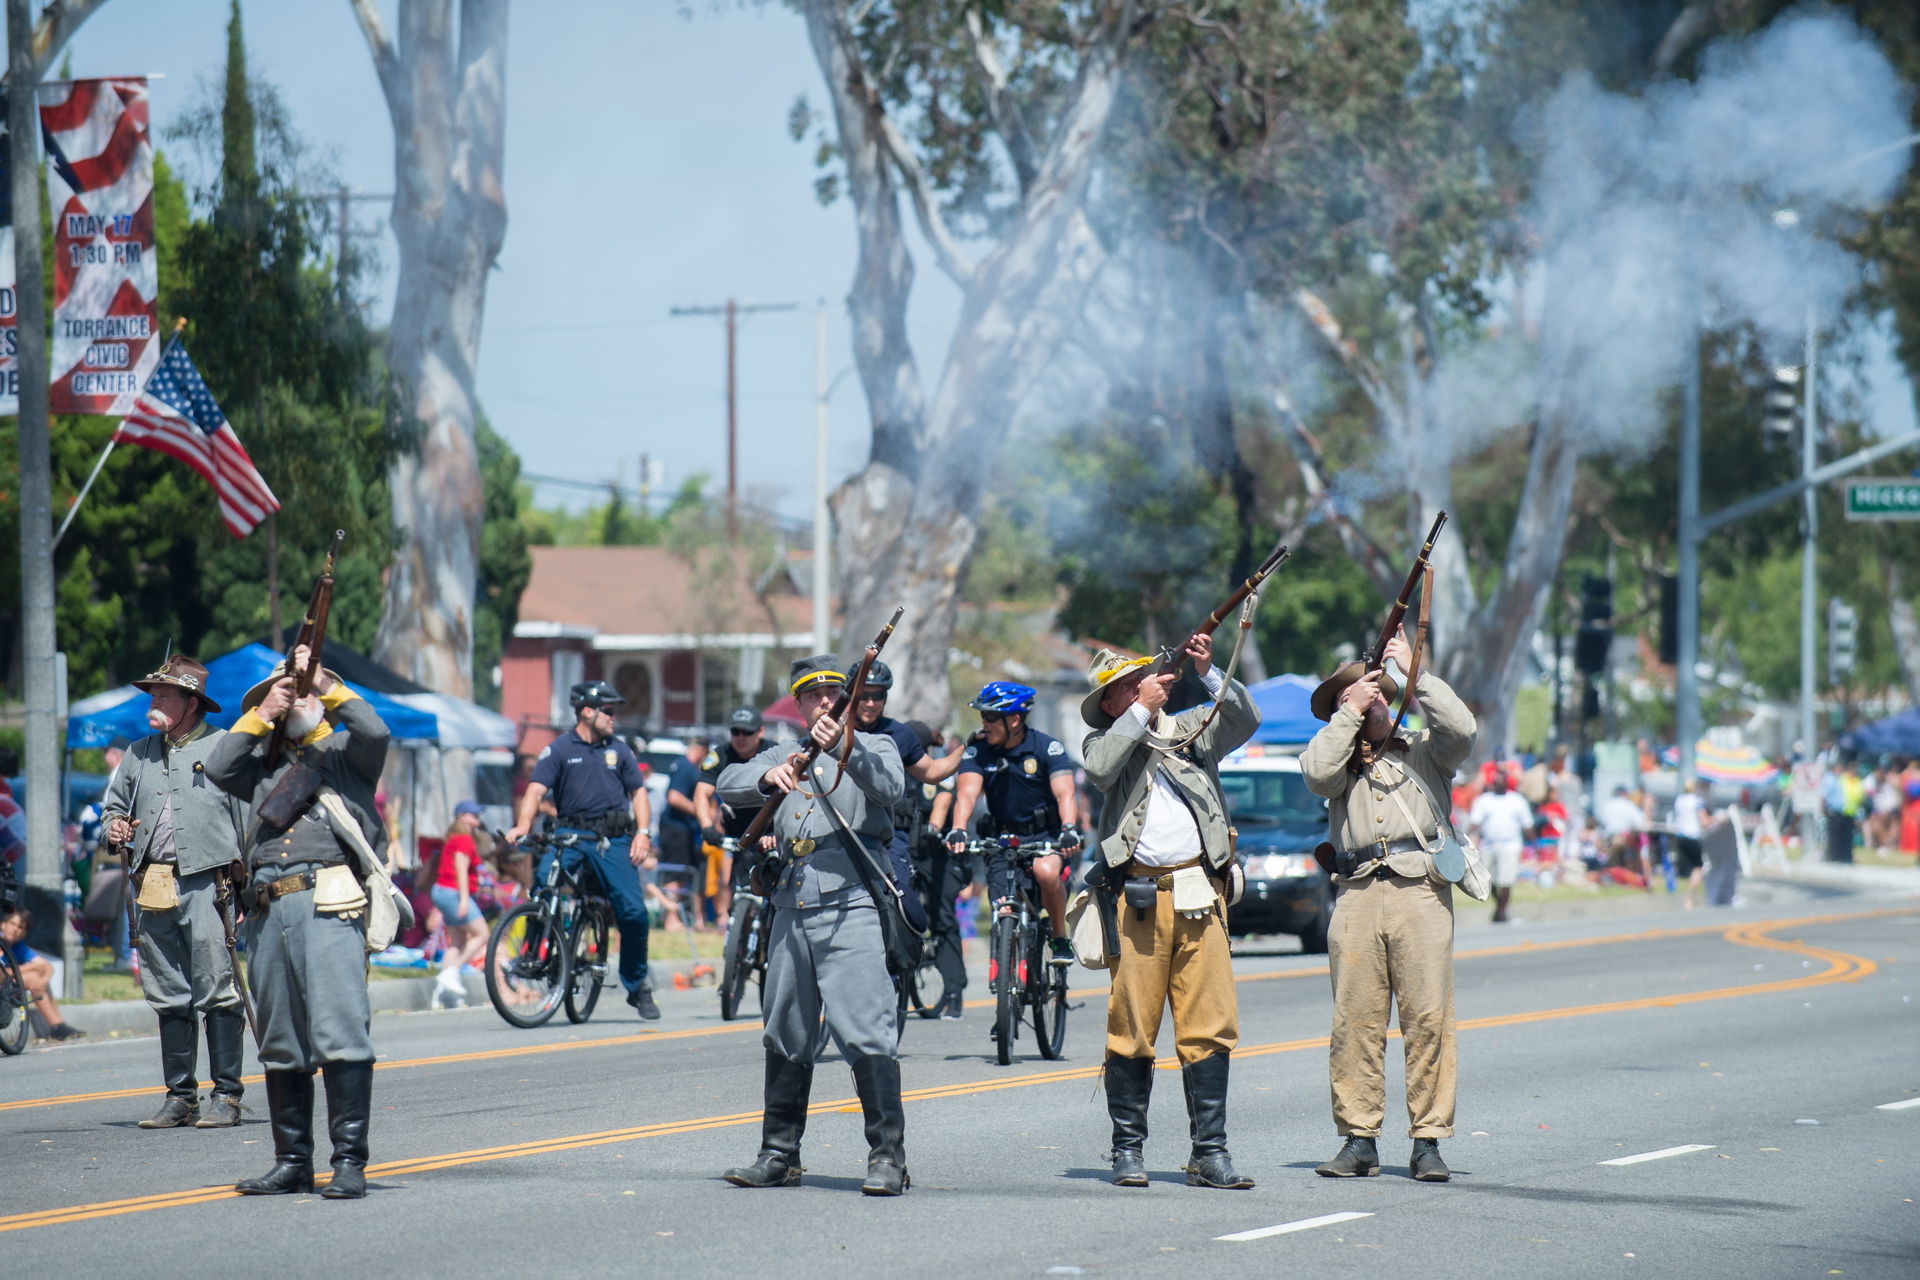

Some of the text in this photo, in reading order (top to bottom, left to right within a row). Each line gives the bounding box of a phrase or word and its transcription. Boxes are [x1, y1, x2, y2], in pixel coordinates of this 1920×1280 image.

[68, 214, 133, 236] MAY 17
[70, 242, 141, 265] 1:30 PM
[64, 316, 148, 338] TORRANCE
[86, 344, 129, 366] CIVIC
[74, 373, 137, 393] CENTER
